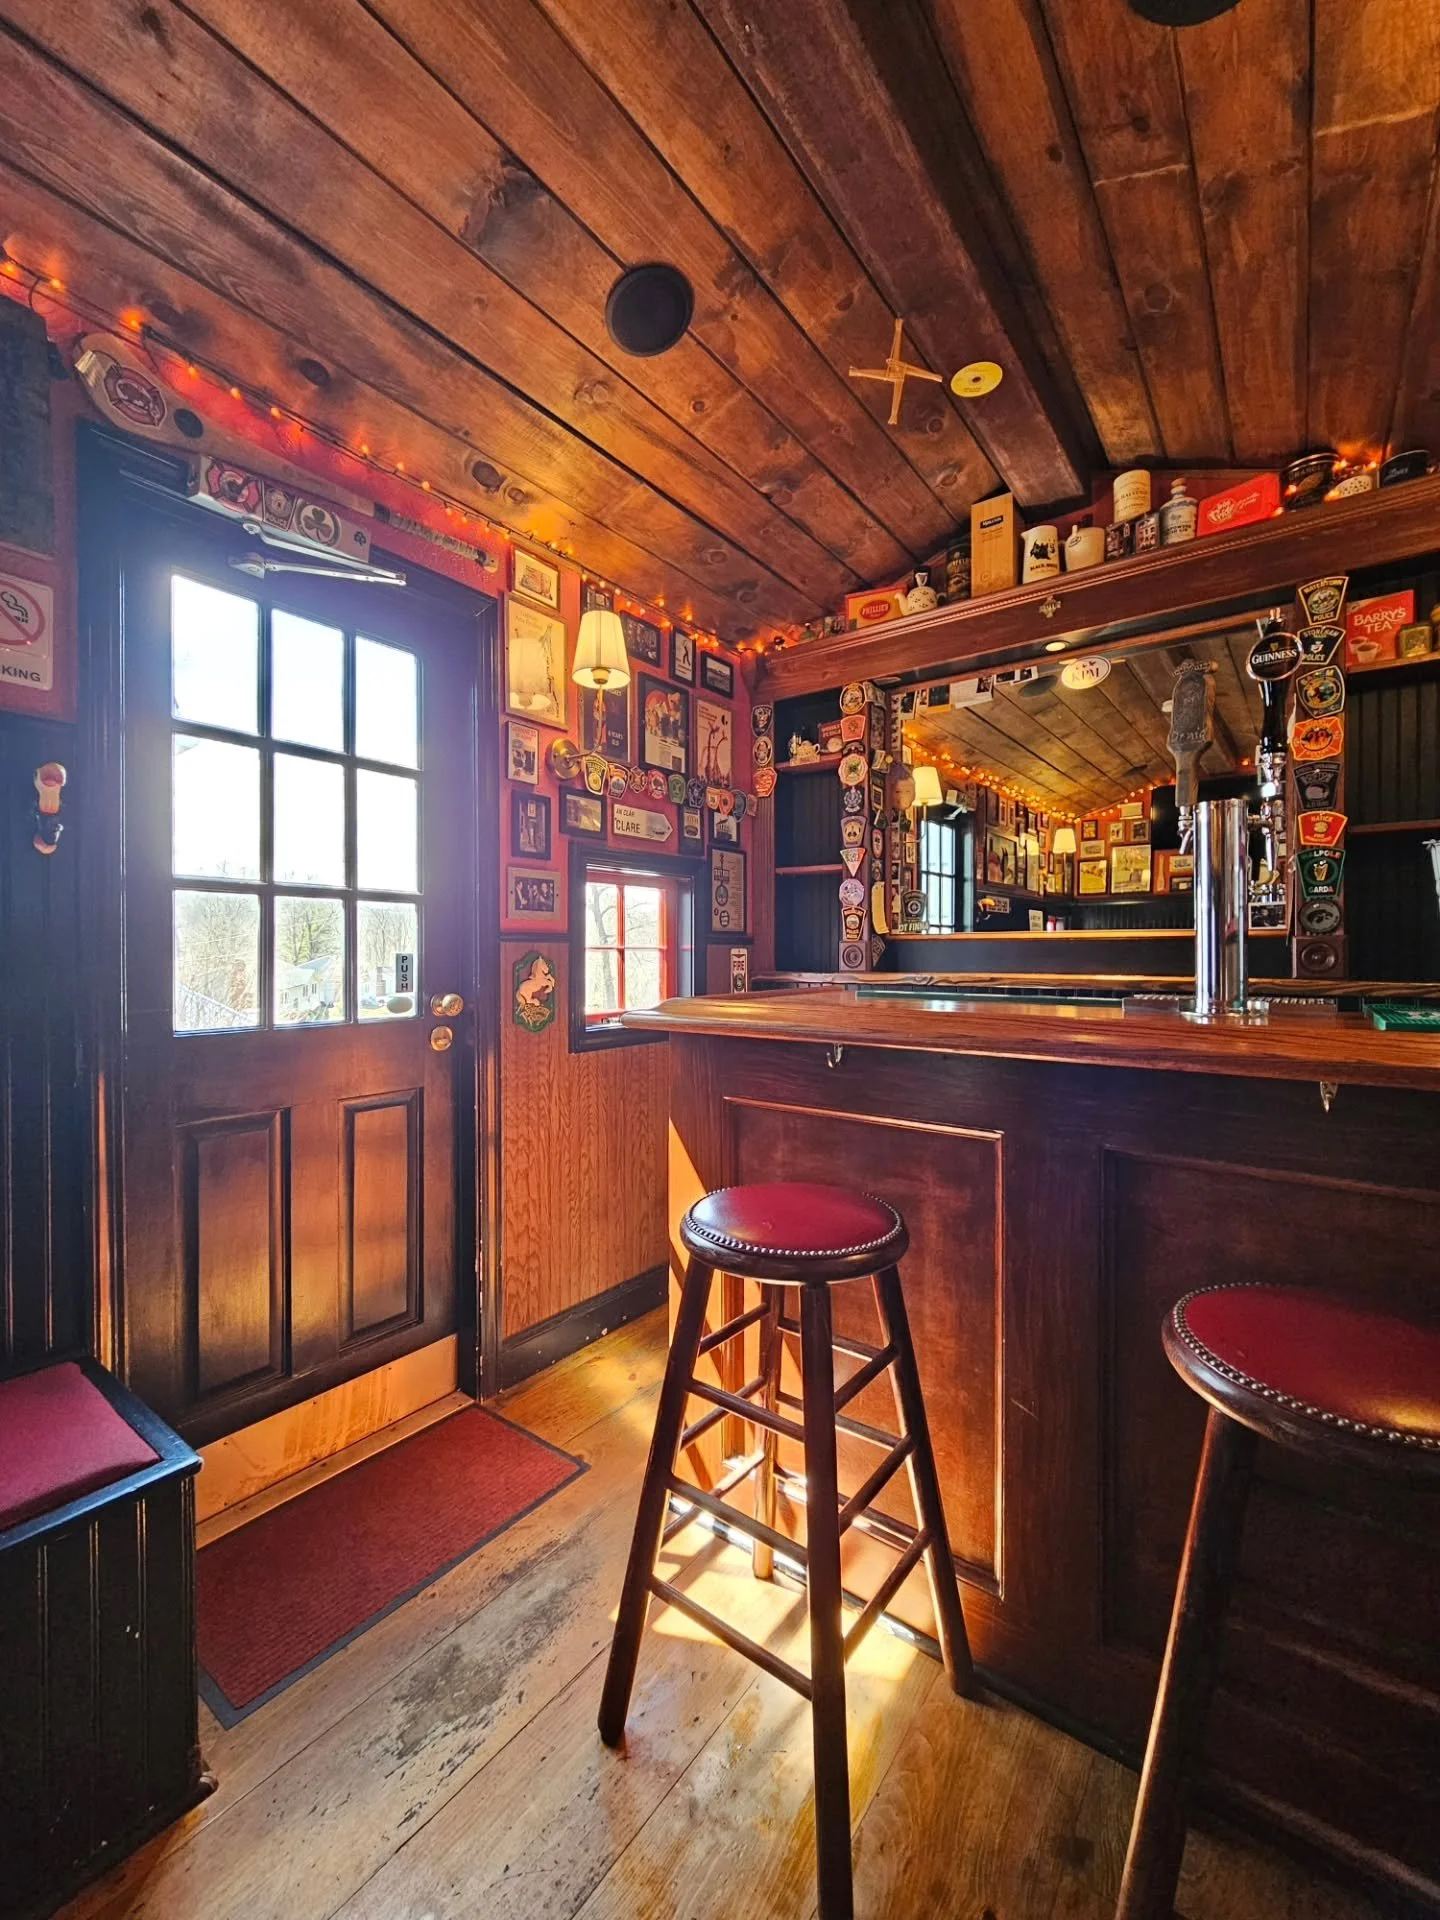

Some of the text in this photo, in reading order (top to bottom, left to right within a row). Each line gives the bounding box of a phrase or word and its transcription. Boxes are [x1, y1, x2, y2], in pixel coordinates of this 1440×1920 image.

[862, 603, 889, 616] PHILLIES
[1313, 611, 1335, 622] POLICE
[1354, 607, 1407, 627] BARRY'S
[1364, 620, 1393, 634] TEA
[1251, 649, 1297, 665] GUINNESS
[615, 819, 641, 834] CLARE
[1309, 885, 1334, 894] GARDA
[733, 960, 745, 971] FIRE
[401, 955, 409, 991] PUSH
